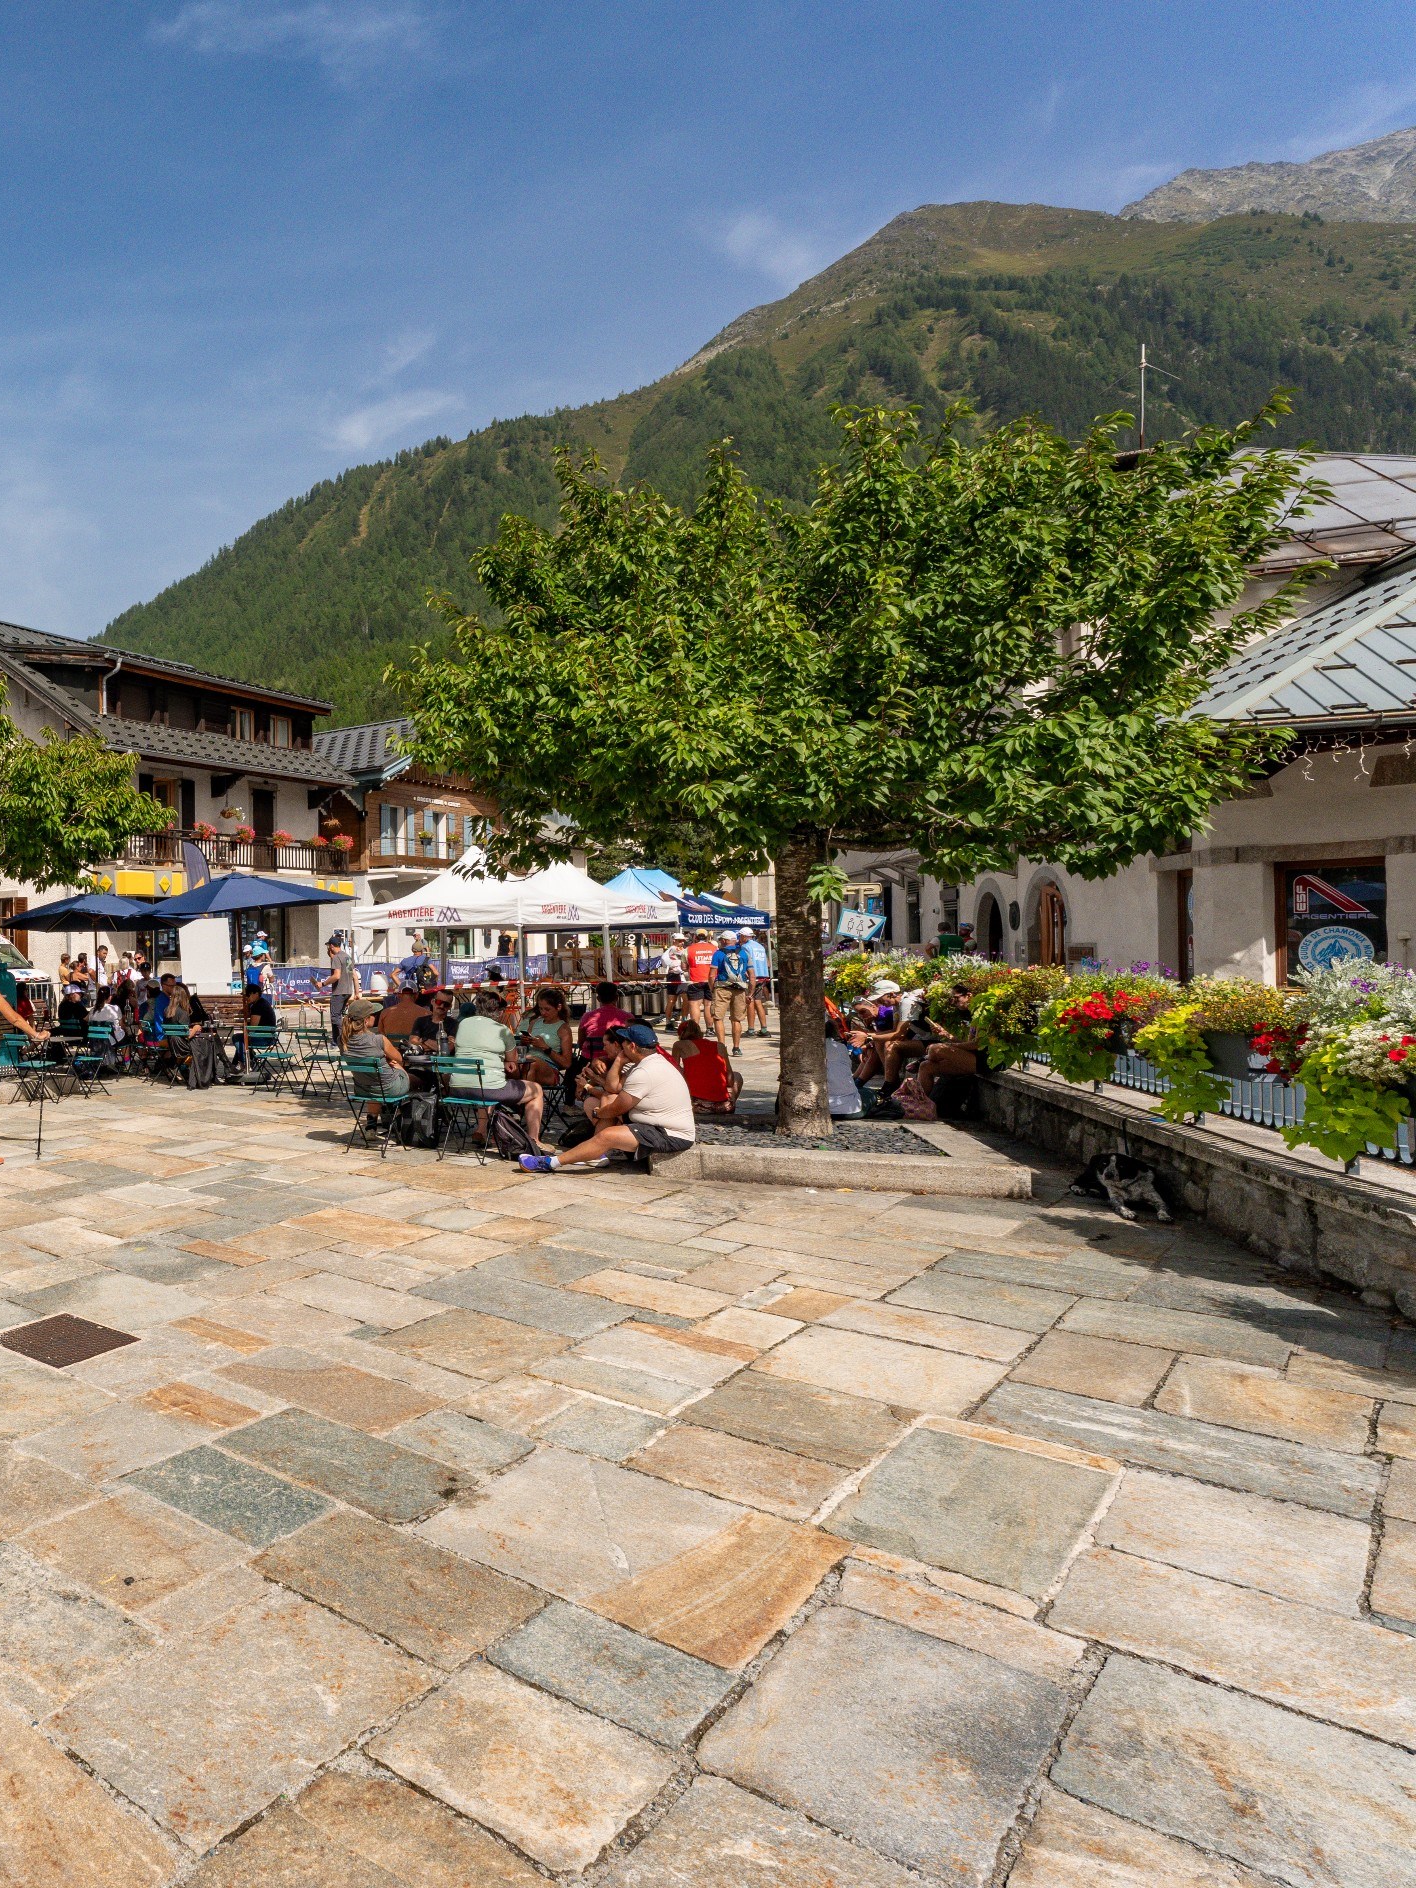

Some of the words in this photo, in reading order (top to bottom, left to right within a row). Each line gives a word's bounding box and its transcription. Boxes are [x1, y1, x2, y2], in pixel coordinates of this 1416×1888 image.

[1295, 885, 1306, 911] ESF
[687, 914, 703, 924] CLUB
[703, 914, 714, 924] DES
[1300, 939, 1312, 960] GUIDES
[1310, 931, 1321, 940] DE
[1323, 927, 1366, 944] CHAMONIX
